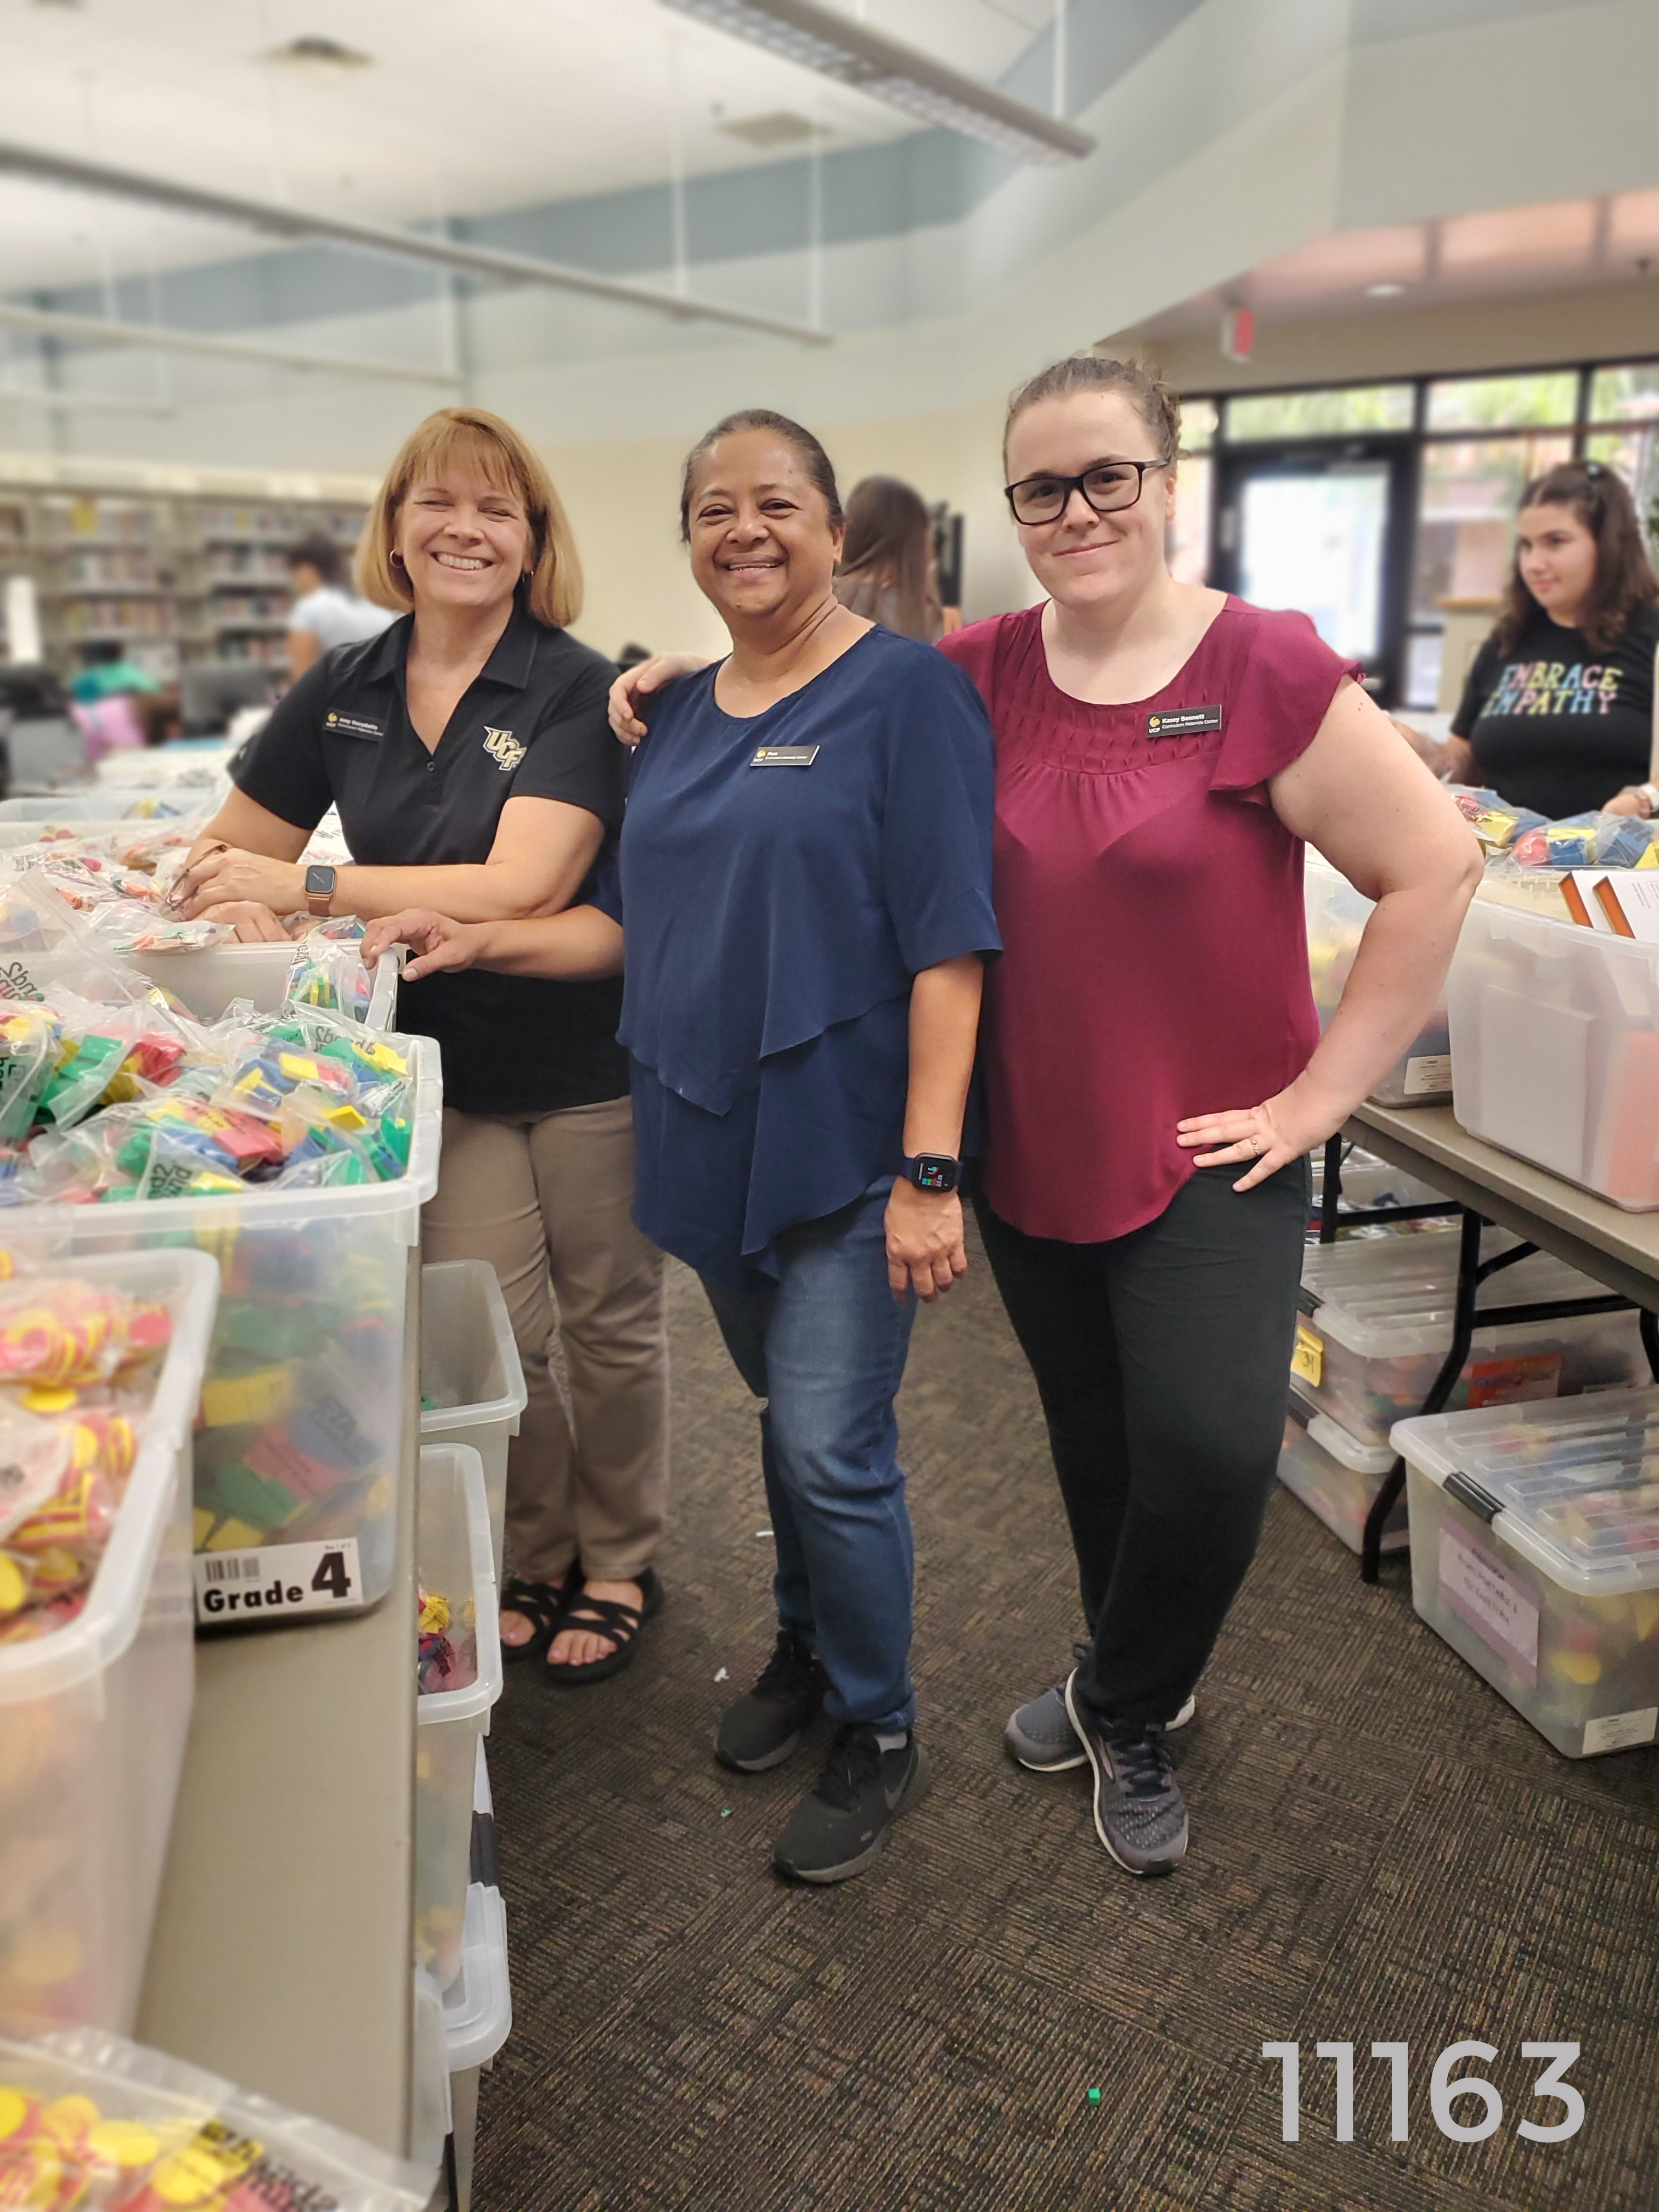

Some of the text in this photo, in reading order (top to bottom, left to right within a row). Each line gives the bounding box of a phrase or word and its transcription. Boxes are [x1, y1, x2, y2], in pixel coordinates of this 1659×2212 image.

[1497, 660, 1624, 691] EMBRACE
[1480, 689, 1617, 718] EMPATHY
[483, 725, 527, 771] UCF
[204, 1551, 352, 1612] Grade 4
